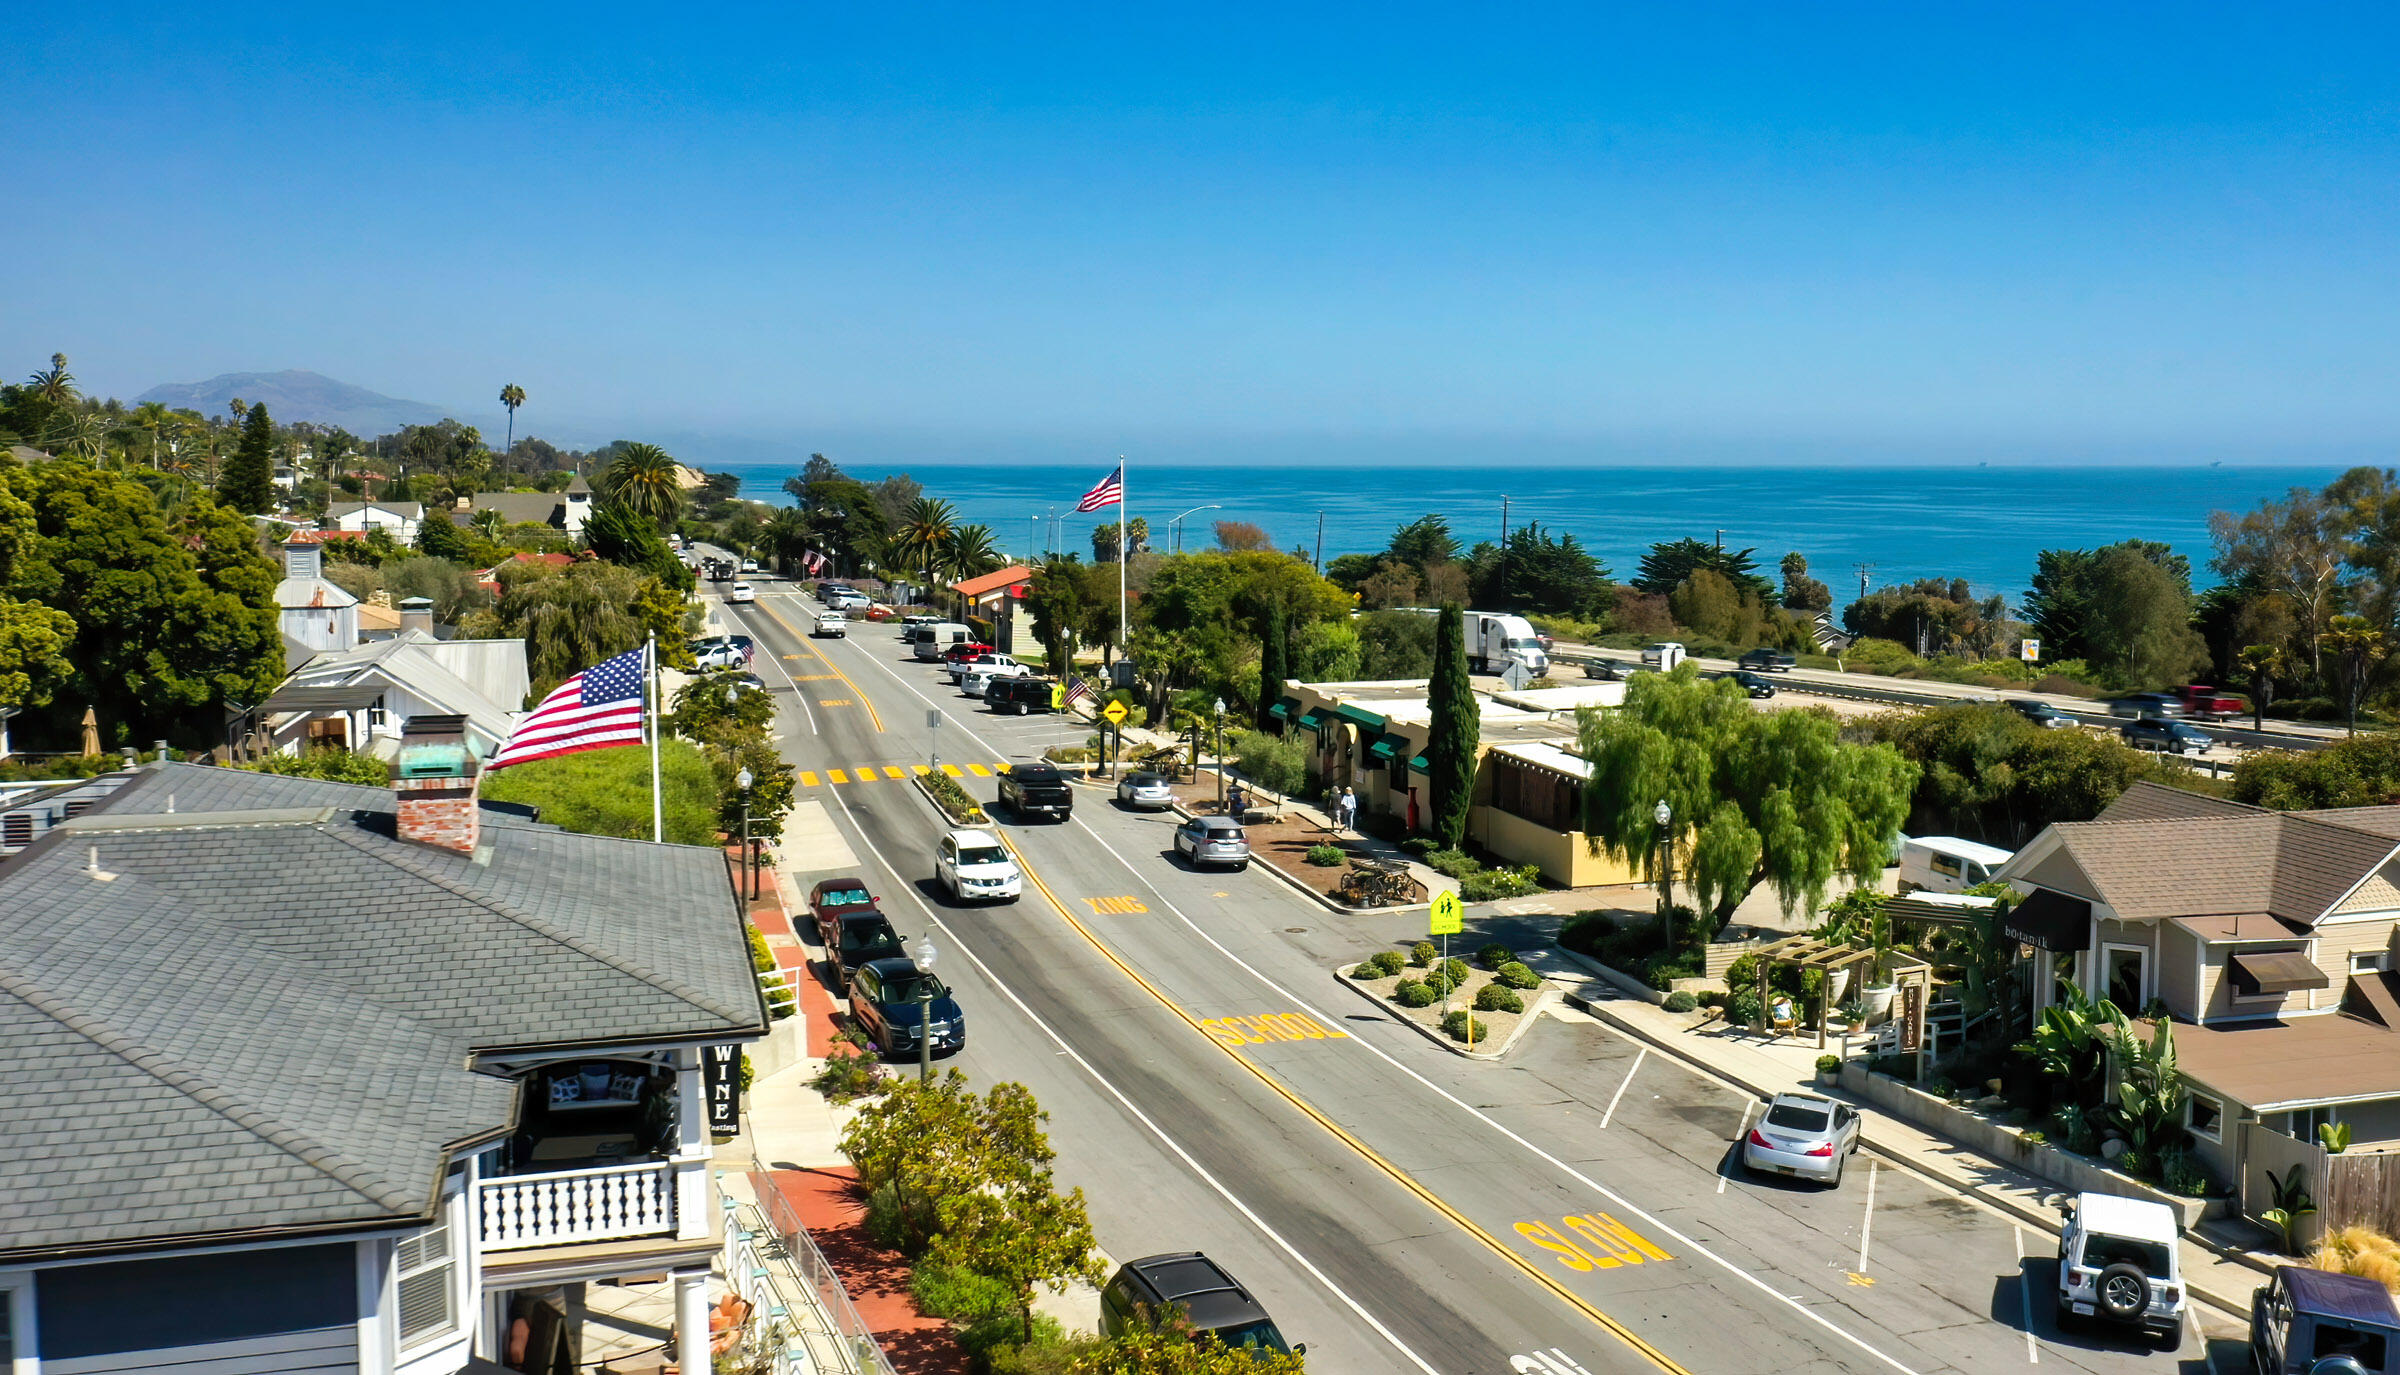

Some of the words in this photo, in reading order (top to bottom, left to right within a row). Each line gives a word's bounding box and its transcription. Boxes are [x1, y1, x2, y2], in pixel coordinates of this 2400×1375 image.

[1081, 896, 1149, 914] XING
[1201, 1013, 1350, 1046] SCHOOL
[714, 1045, 733, 1120] WINE
[1513, 1212, 1675, 1272] SLOW
